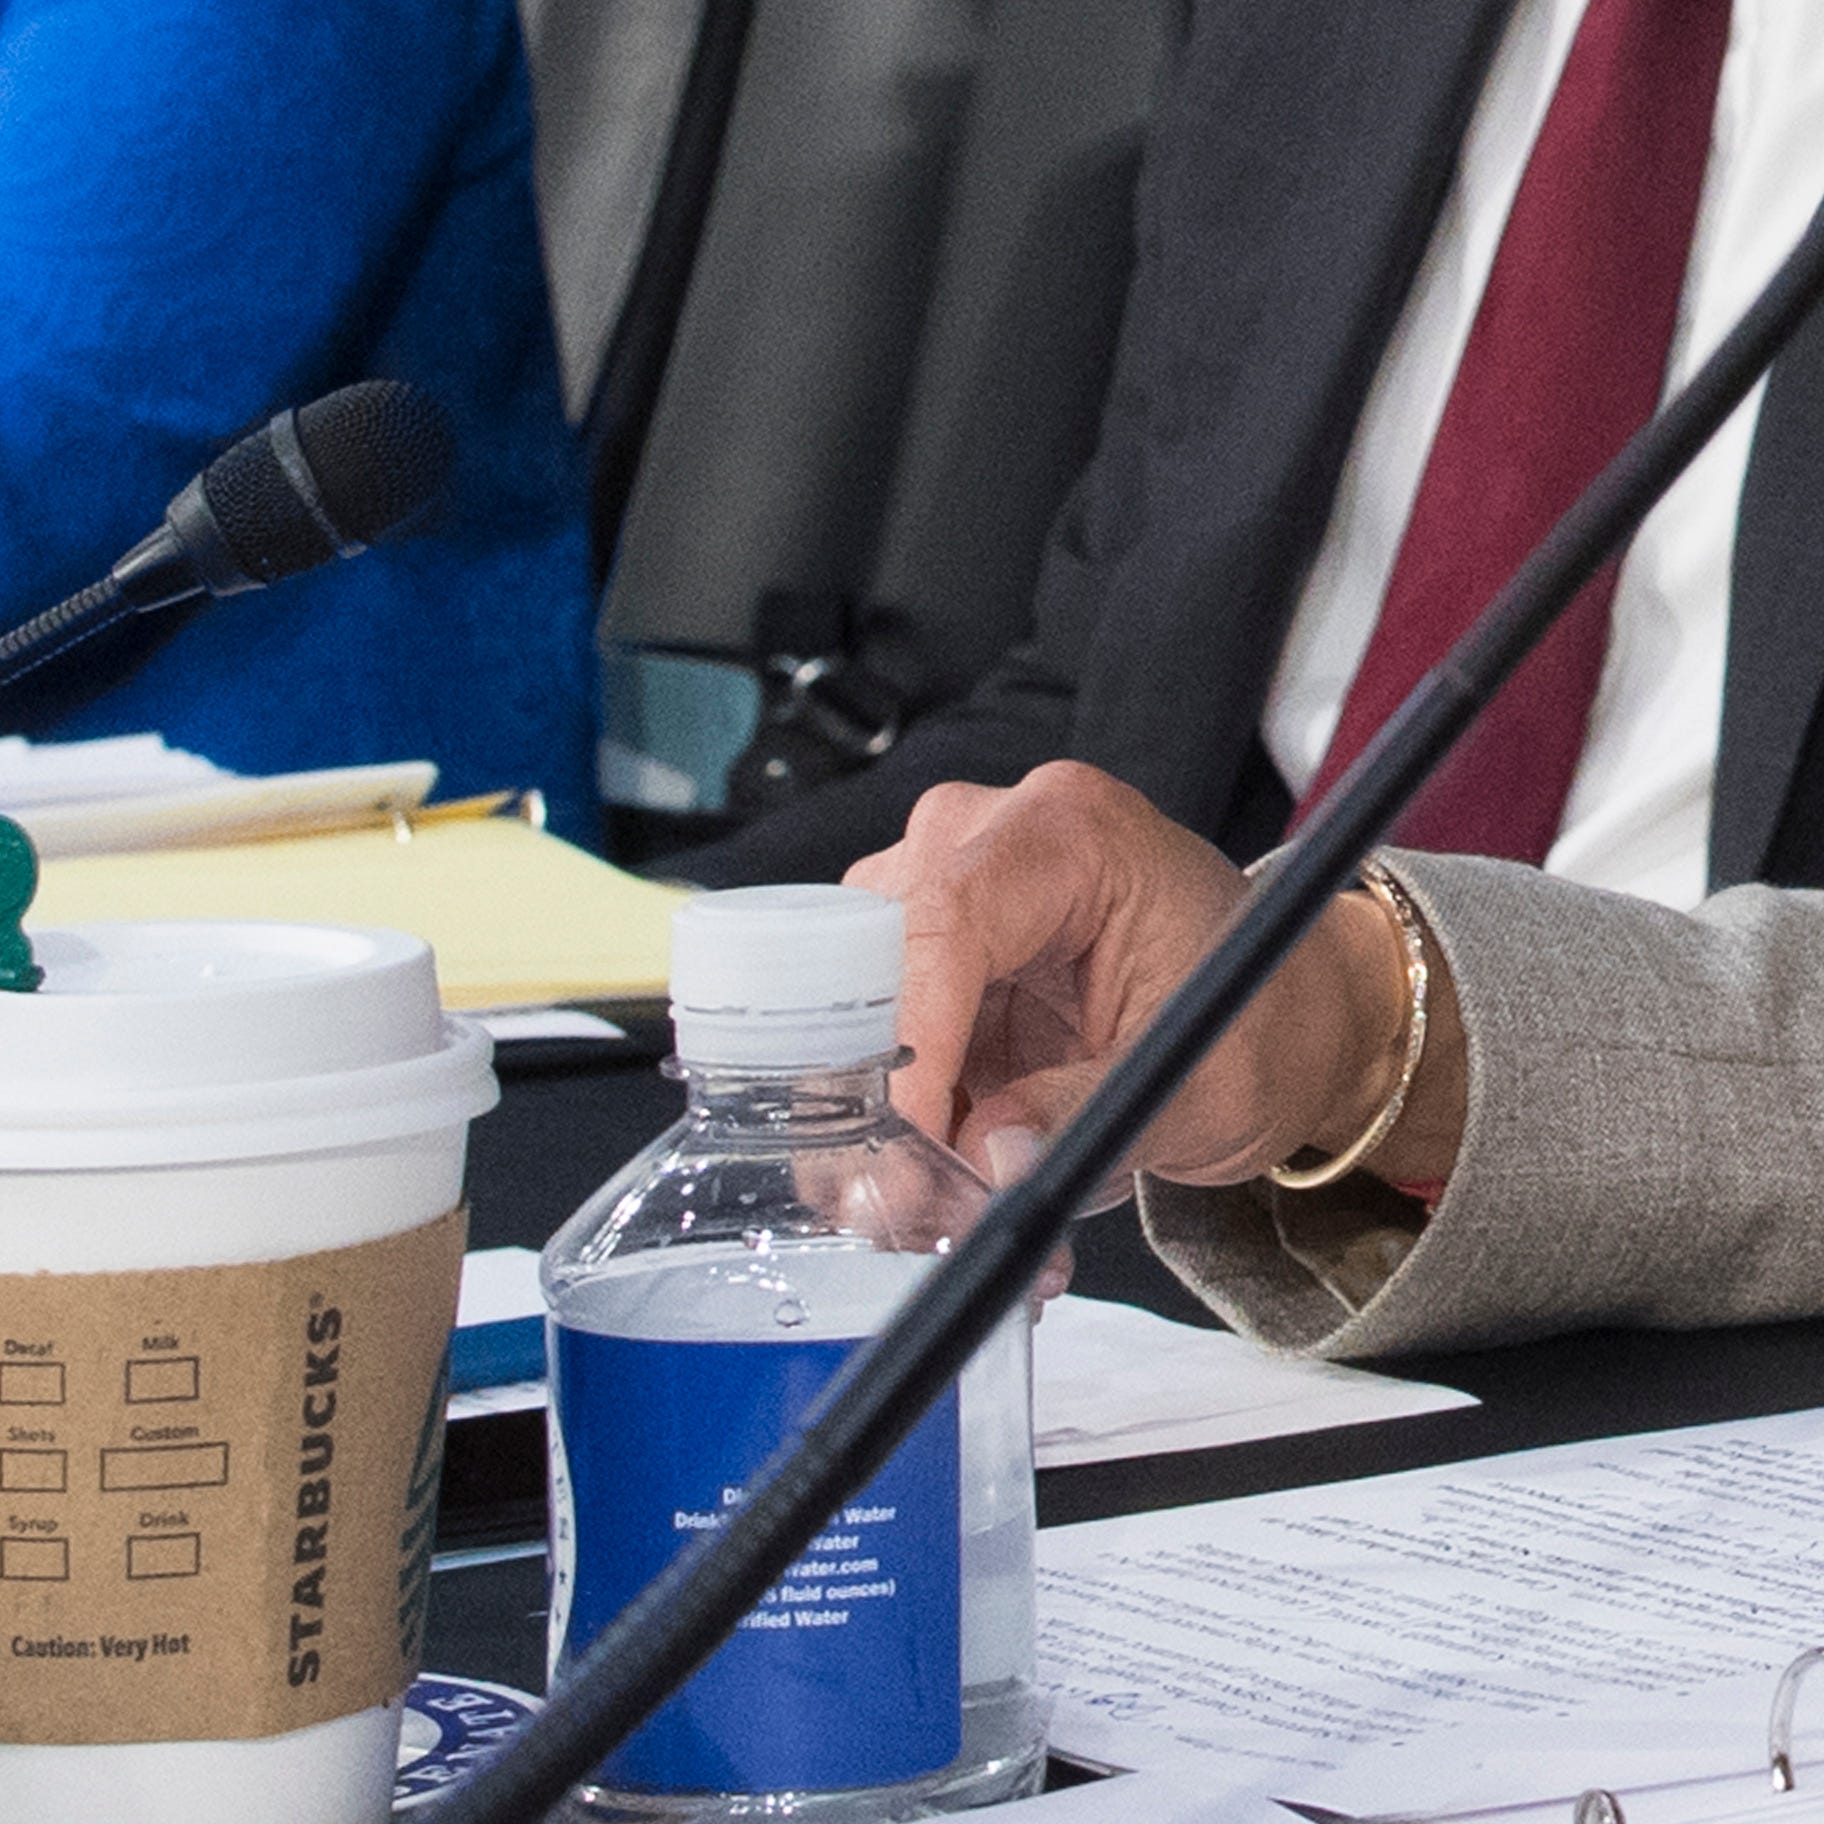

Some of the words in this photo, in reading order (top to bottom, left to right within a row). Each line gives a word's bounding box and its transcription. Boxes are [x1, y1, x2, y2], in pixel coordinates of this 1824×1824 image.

[4, 1339, 53, 1356] Decaf
[142, 1335, 179, 1351] Milk
[8, 1427, 55, 1442] Shots
[130, 1426, 199, 1441] Custom
[289, 1306, 343, 1688] STARBUCKS
[140, 1512, 189, 1527] Drink
[844, 1506, 896, 1524] Water
[9, 1516, 59, 1533] Syrup
[781, 1586, 823, 1603] fluid
[826, 1579, 896, 1600] ounces)
[794, 1610, 849, 1627] Water
[12, 1635, 96, 1658] Caution:
[100, 1634, 148, 1662] Very
[152, 1632, 191, 1655] Hot
